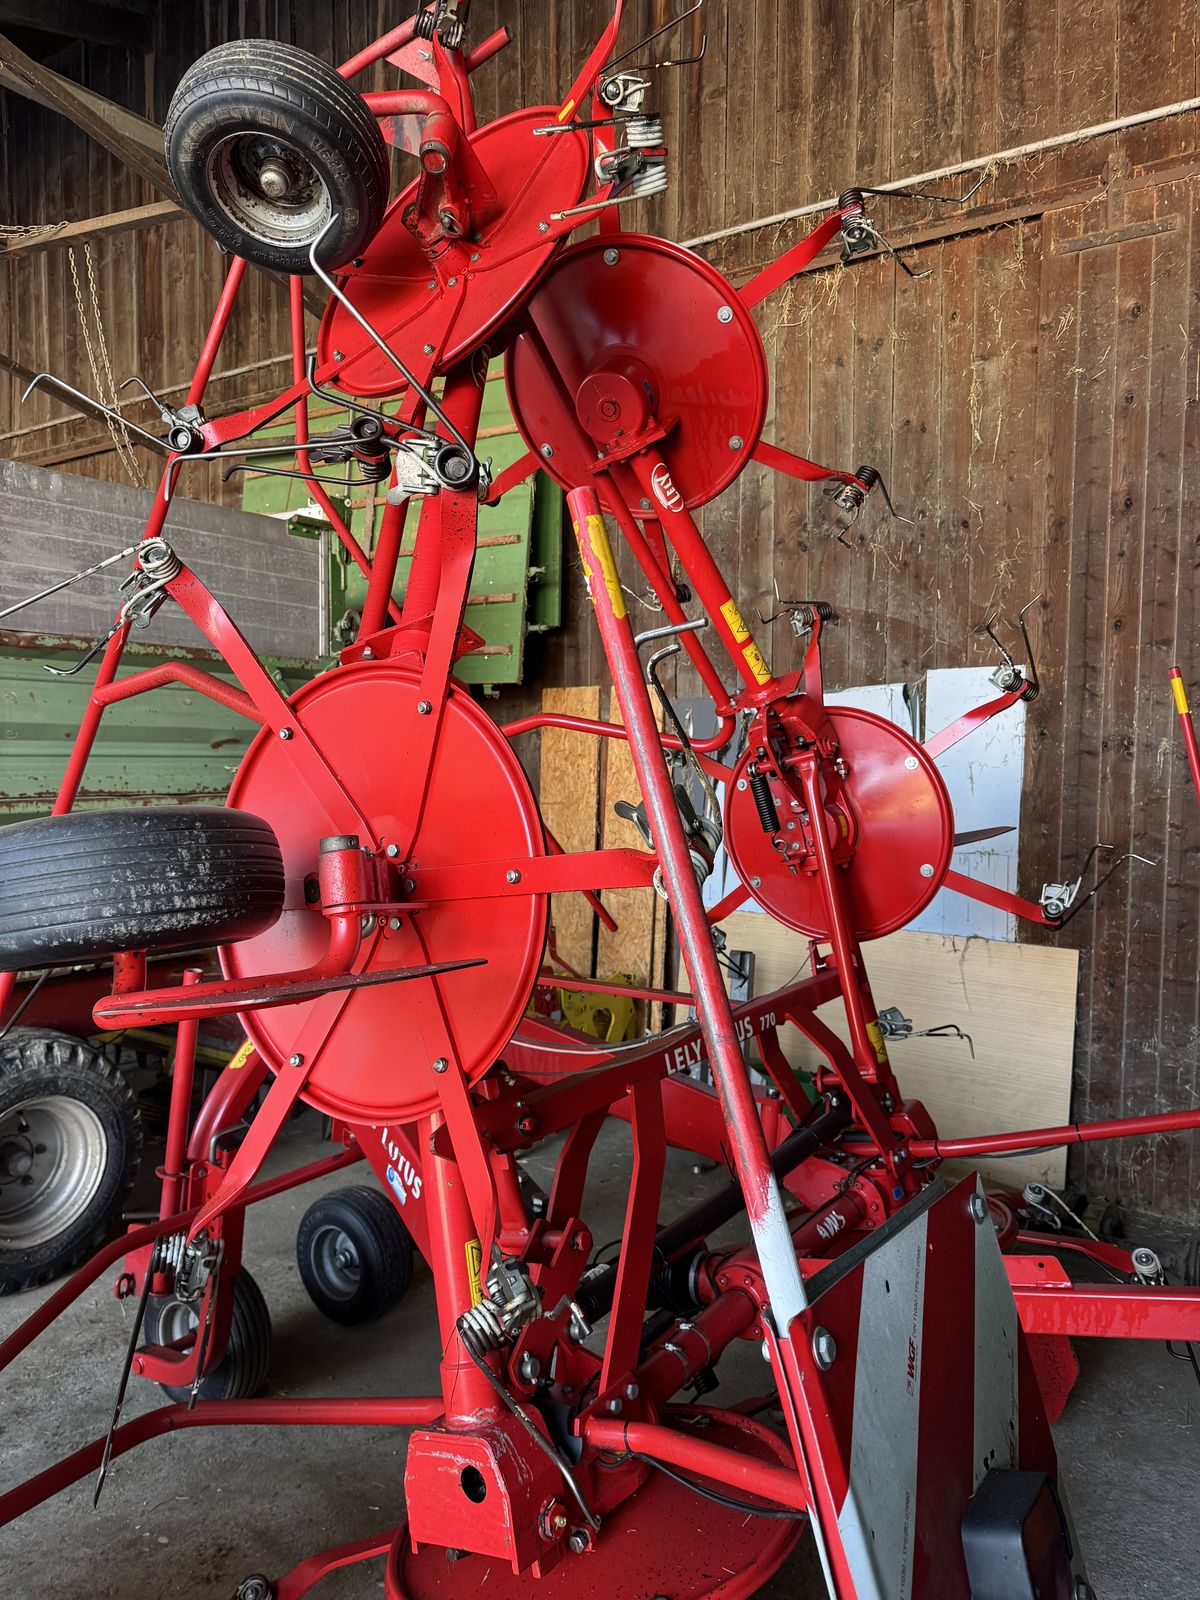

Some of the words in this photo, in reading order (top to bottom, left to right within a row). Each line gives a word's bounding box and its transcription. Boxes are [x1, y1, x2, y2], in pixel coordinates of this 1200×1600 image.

[654, 472, 681, 506] LELY
[664, 1039, 702, 1076] LELY
[759, 1011, 776, 1033] 770
[907, 1337, 917, 1379] WGF
